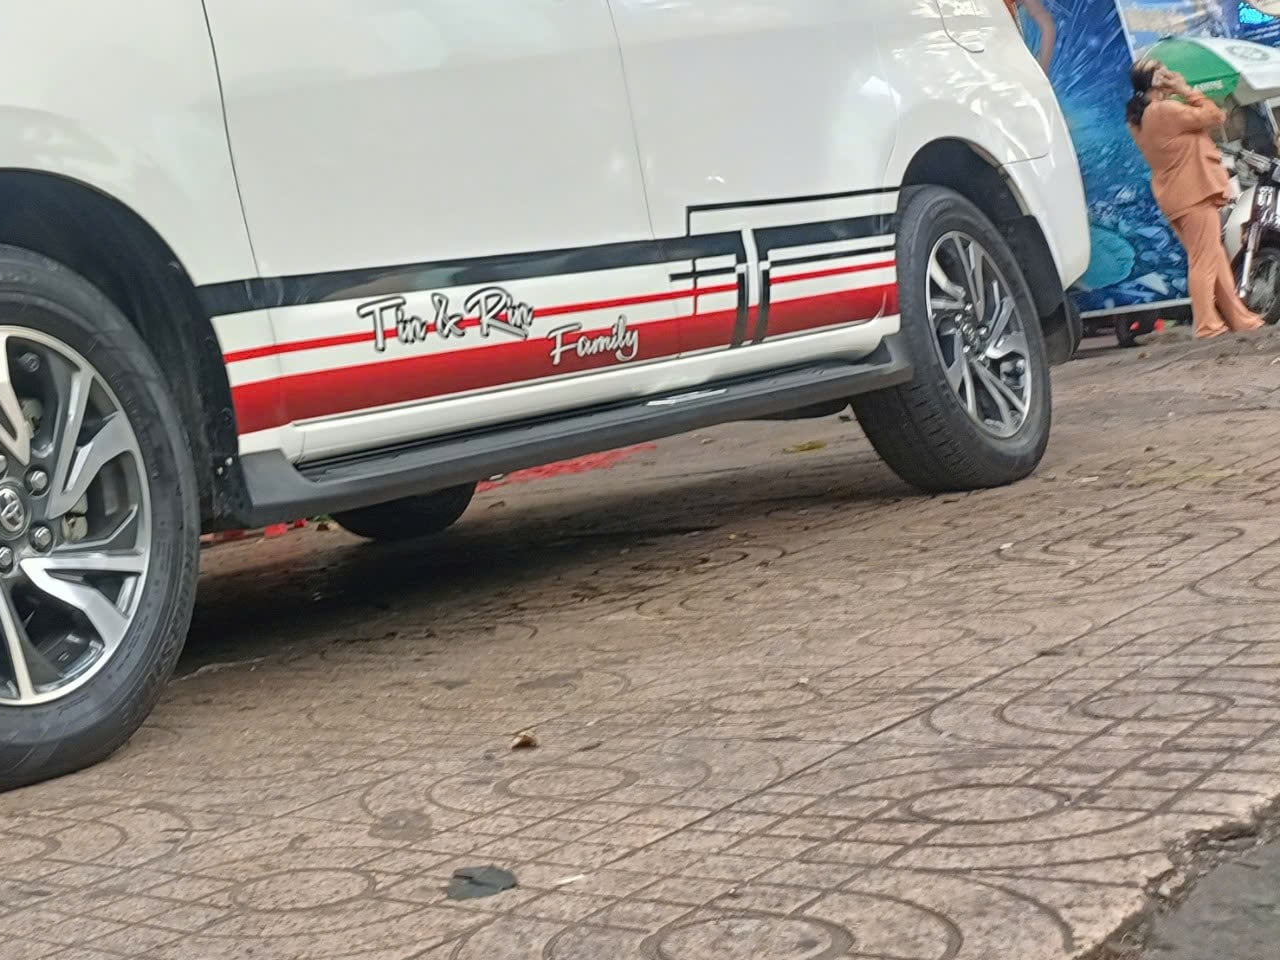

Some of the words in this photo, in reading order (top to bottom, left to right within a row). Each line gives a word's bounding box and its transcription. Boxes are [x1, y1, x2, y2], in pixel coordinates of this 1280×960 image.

[357, 296, 428, 352] Tin
[432, 292, 466, 340] &
[548, 313, 640, 365] Family
